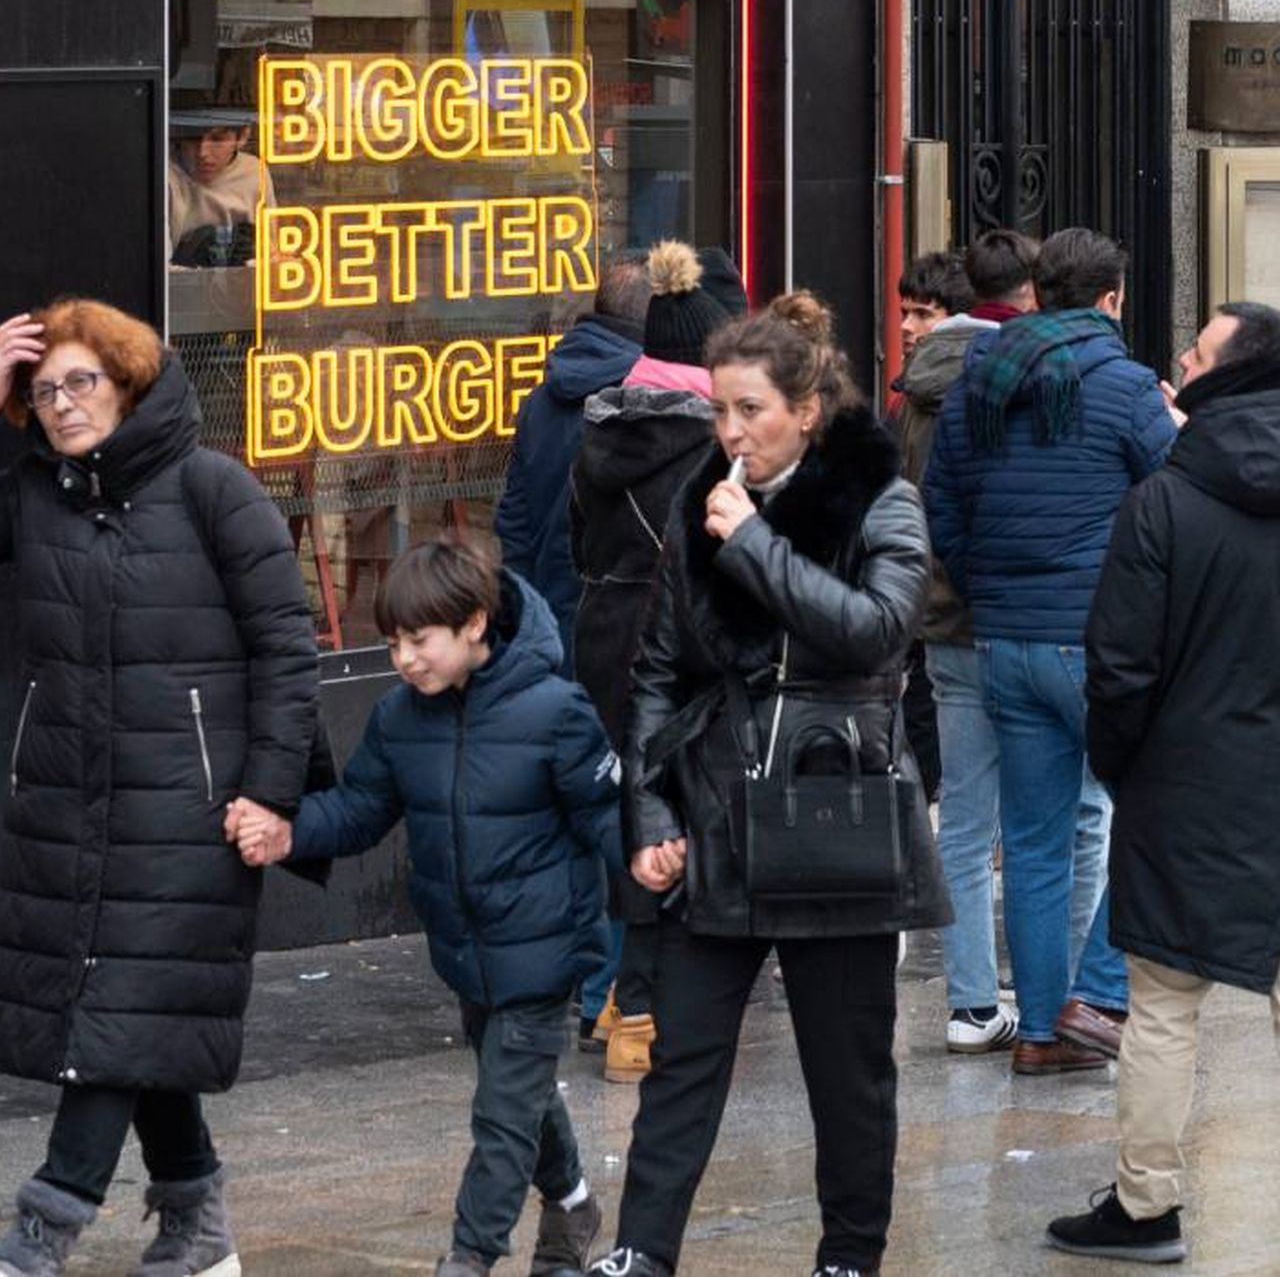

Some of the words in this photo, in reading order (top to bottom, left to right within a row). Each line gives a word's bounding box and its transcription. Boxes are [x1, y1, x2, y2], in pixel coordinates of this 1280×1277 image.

[266, 57, 591, 164] BIGGER
[261, 196, 598, 311] BETTER
[253, 335, 564, 459] BURGE
